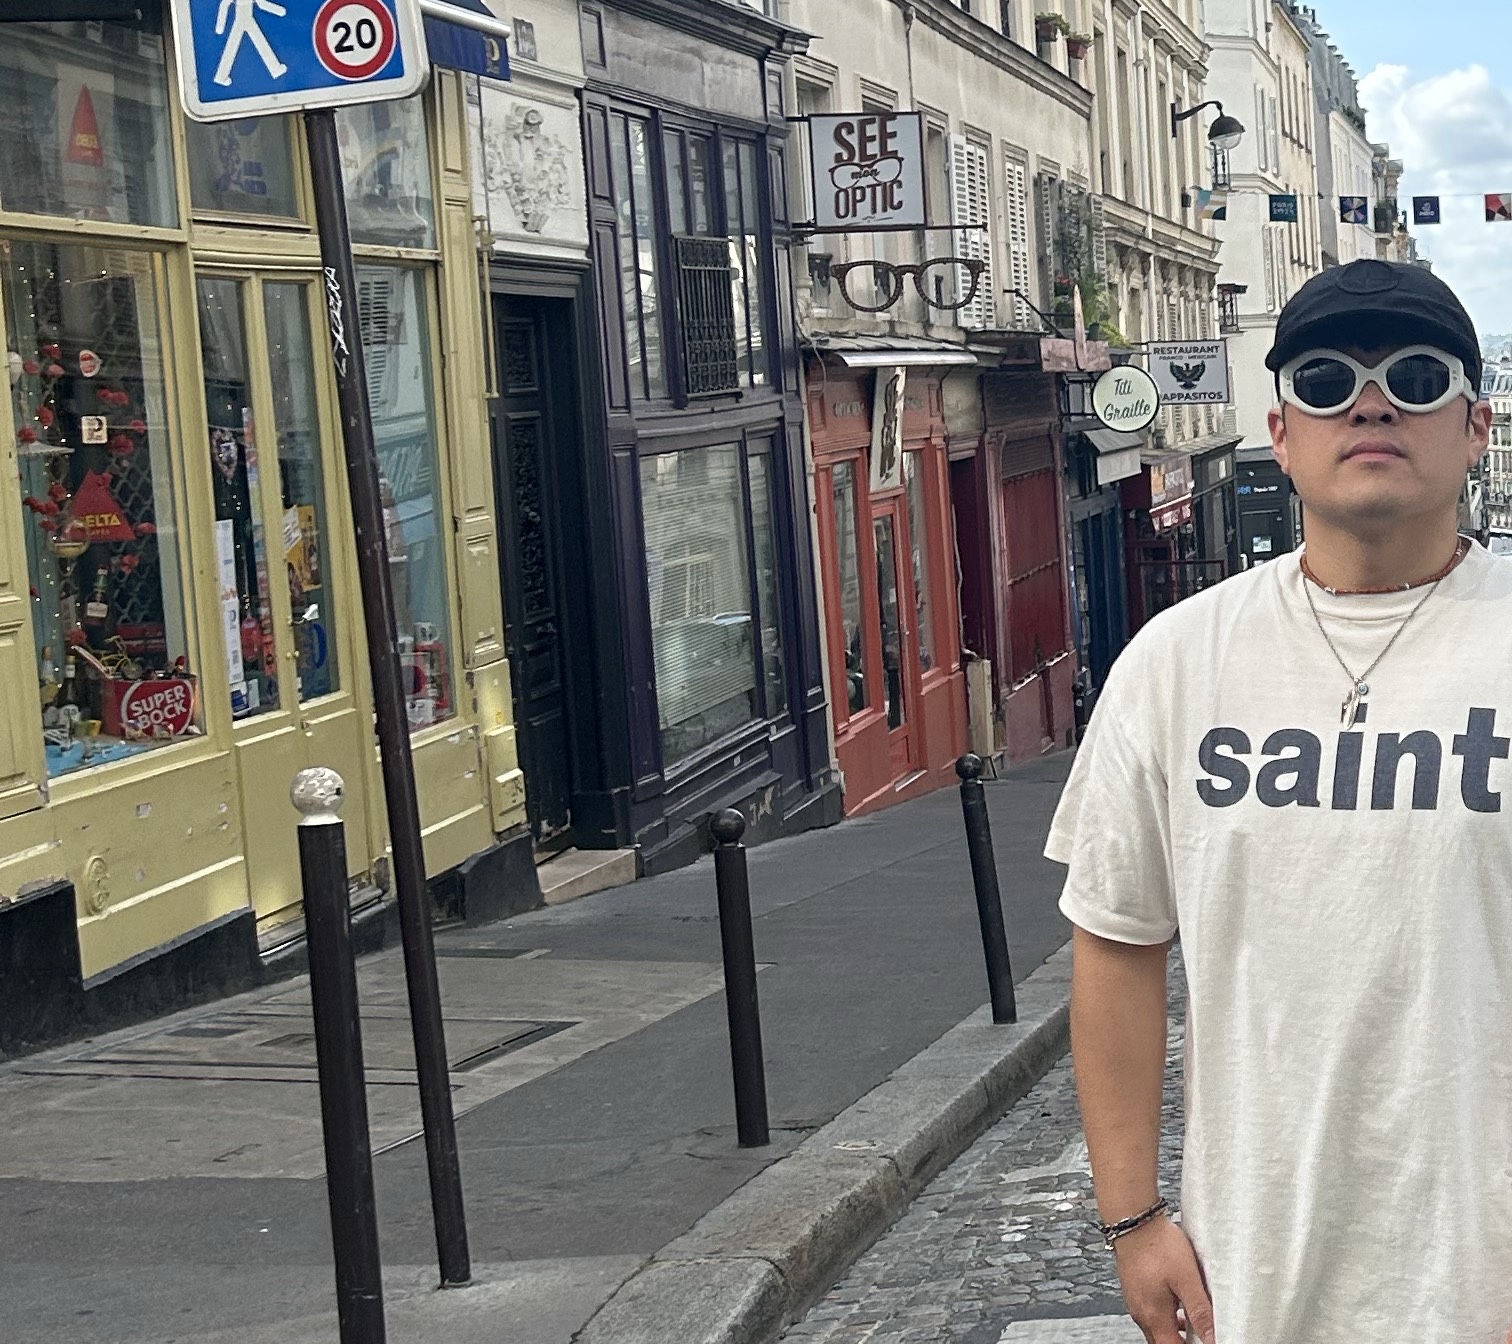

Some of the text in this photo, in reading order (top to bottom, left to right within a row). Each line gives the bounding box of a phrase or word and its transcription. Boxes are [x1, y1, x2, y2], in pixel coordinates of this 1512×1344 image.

[332, 18, 377, 54] 20
[833, 116, 899, 164] SEE
[834, 179, 904, 220] OPTIC
[1153, 345, 1220, 355] RESTAURANT
[1103, 398, 1152, 422] Graille
[74, 512, 122, 527] ELTA
[129, 684, 187, 718] SUPER
[136, 699, 188, 730] BOCK
[1195, 701, 1512, 813] saint
